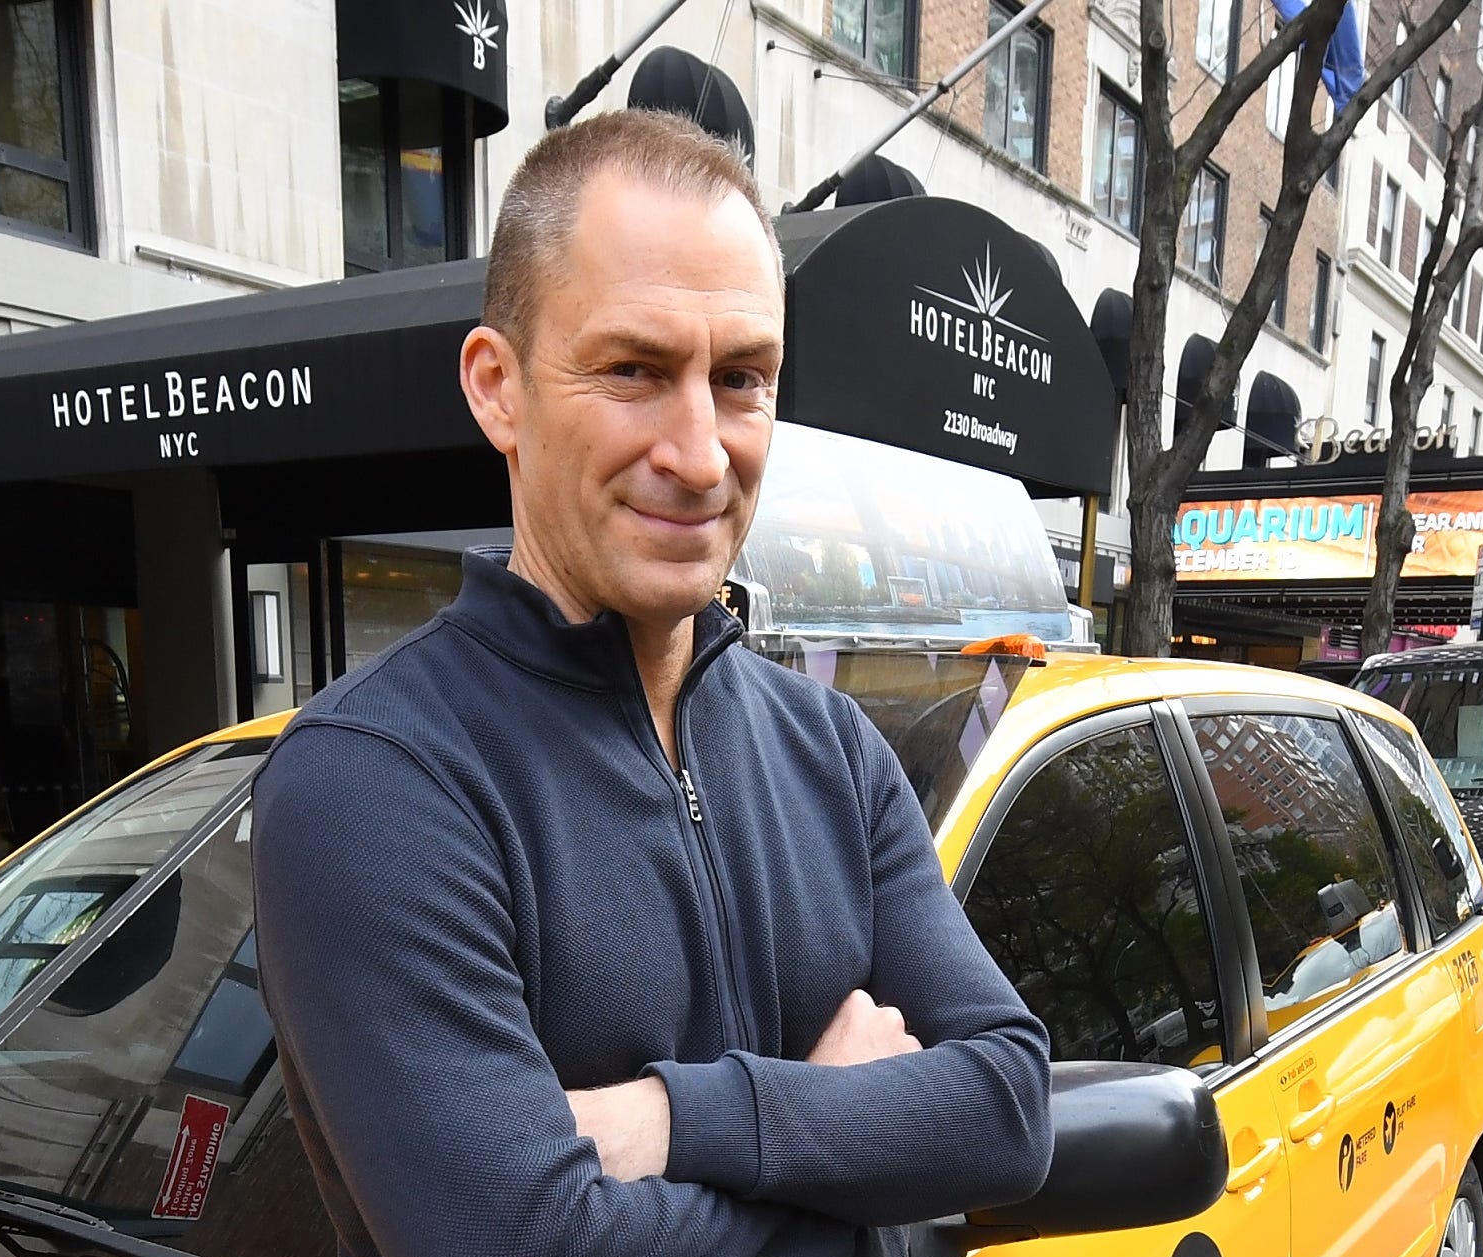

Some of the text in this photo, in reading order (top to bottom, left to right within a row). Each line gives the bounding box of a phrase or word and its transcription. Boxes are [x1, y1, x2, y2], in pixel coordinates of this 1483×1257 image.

[473, 36, 485, 70] B
[973, 372, 996, 400] NYC
[159, 431, 199, 459] NYC
[943, 409, 1018, 456] 2130 Broadway
[1295, 415, 1458, 466] Beaon
[1411, 512, 1452, 533] EAR
[1174, 549, 1270, 572] ECEMBER
